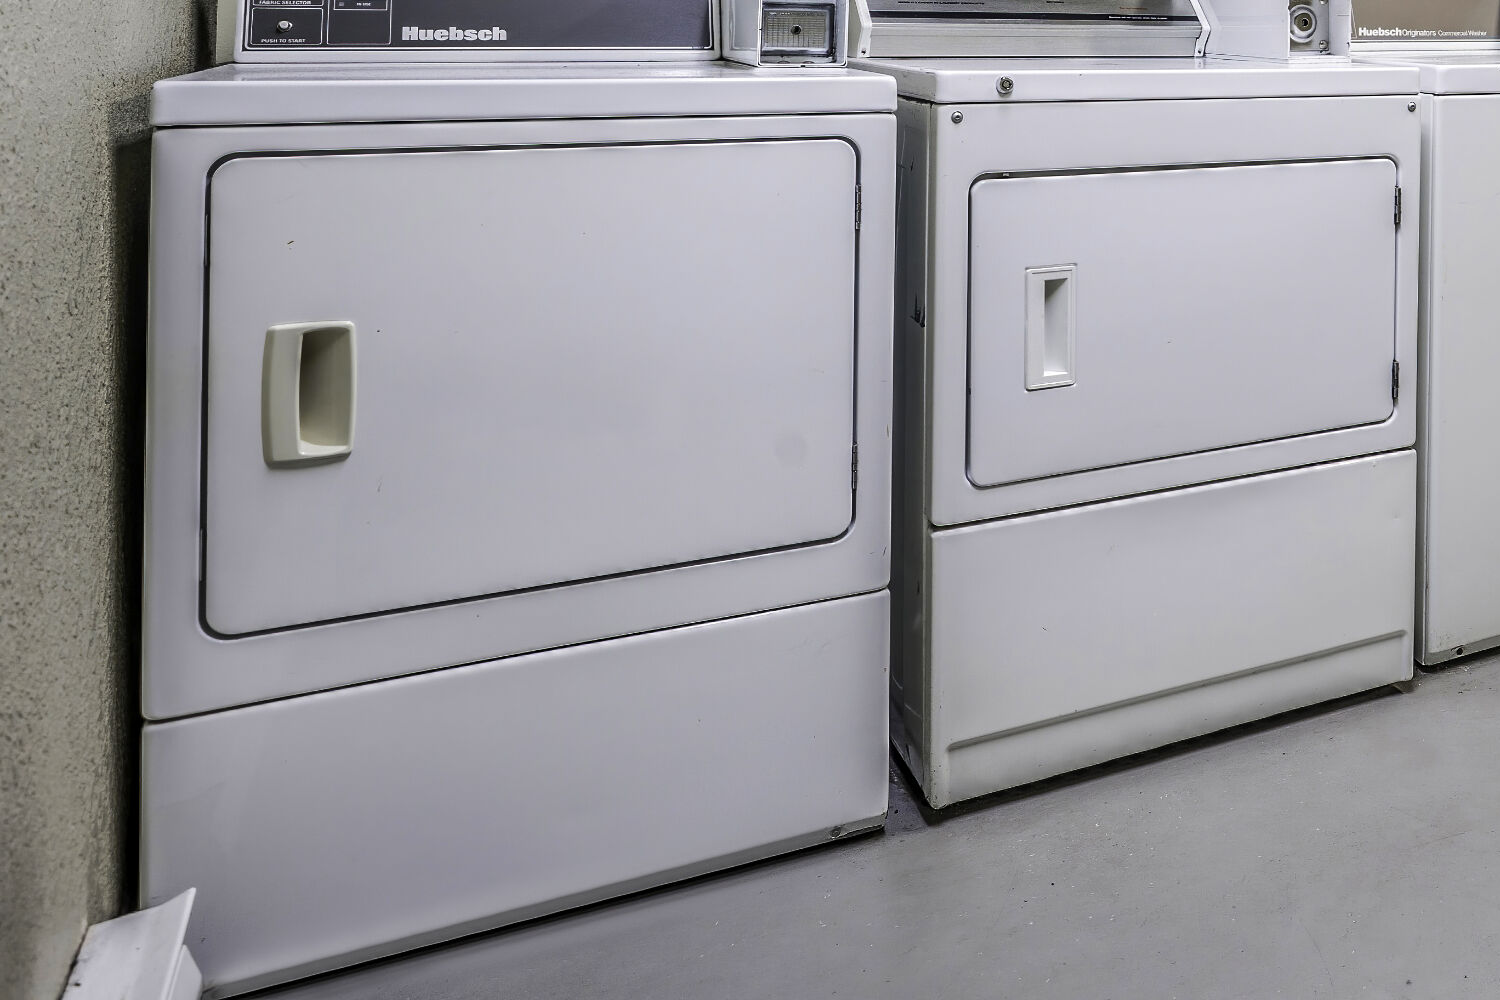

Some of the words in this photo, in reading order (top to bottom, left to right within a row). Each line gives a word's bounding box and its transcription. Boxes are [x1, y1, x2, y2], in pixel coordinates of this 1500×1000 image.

[402, 26, 506, 41] Huebsch
[1359, 27, 1402, 37] Huebsch
[1402, 28, 1437, 38] Originators
